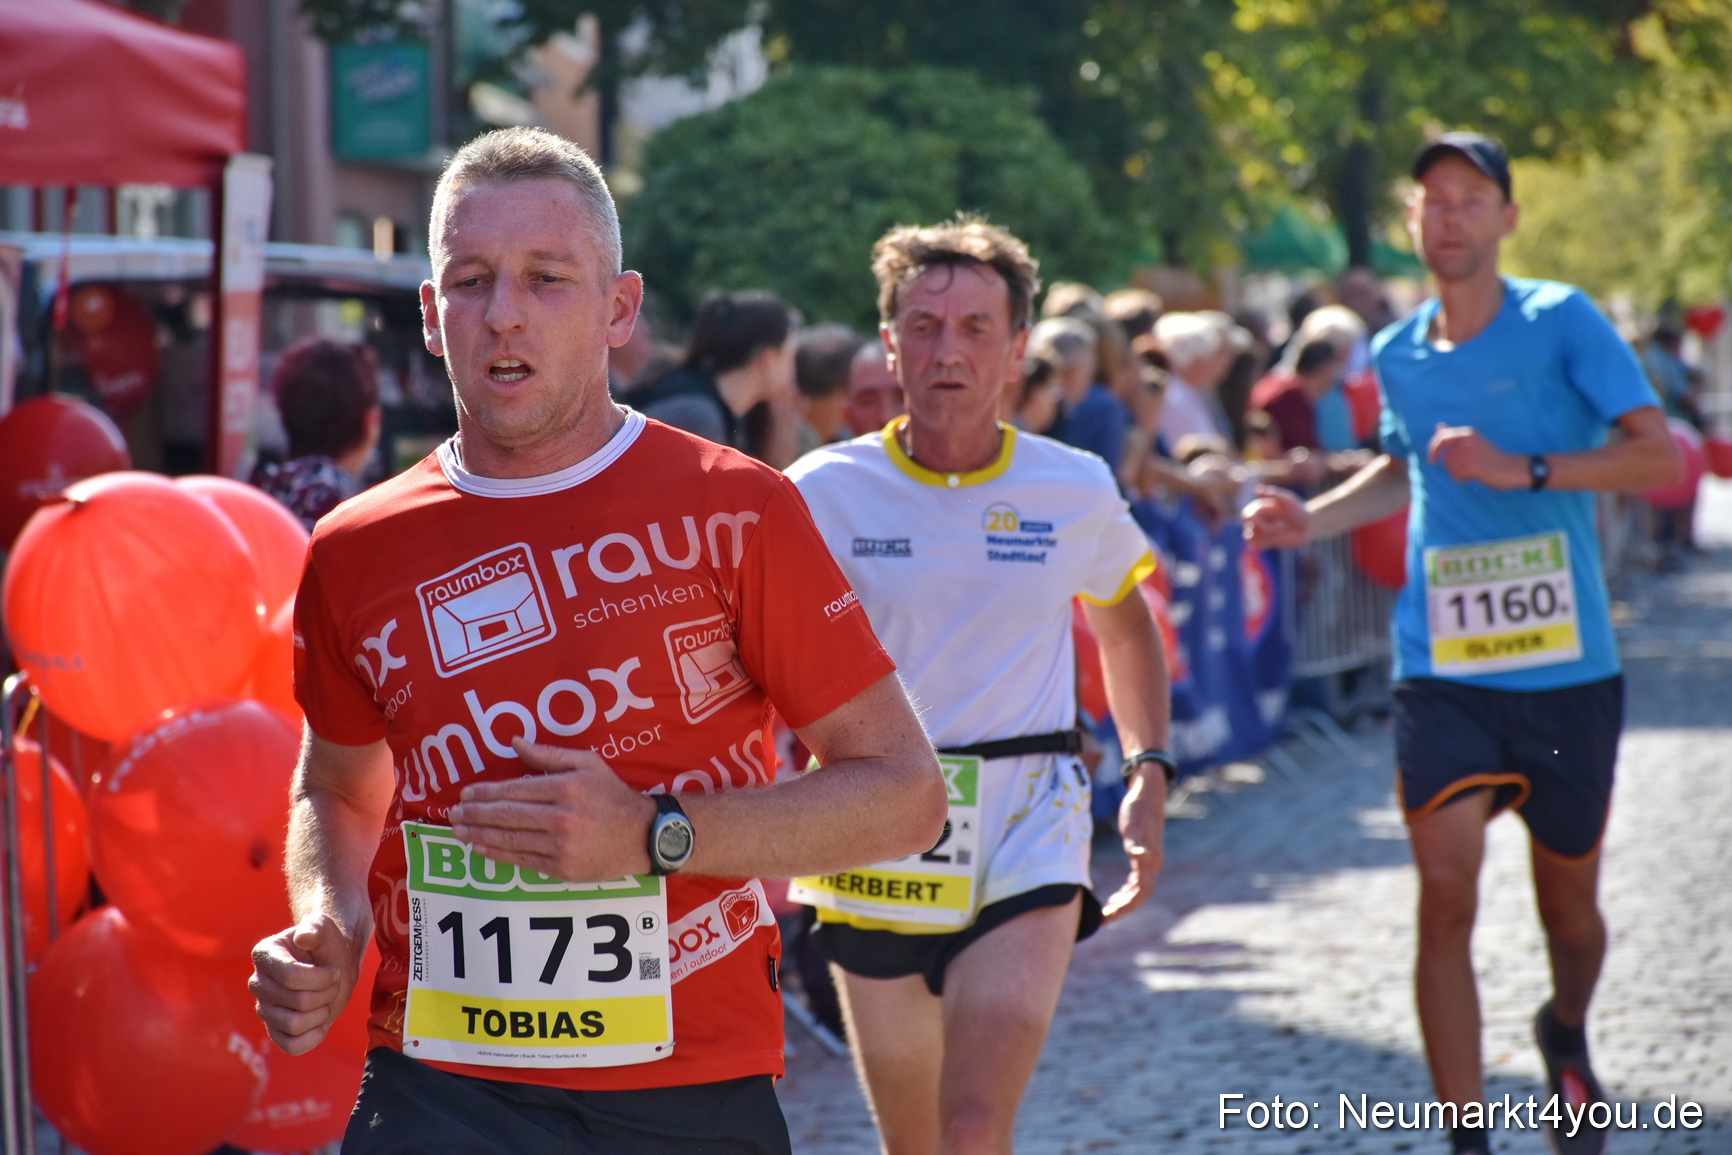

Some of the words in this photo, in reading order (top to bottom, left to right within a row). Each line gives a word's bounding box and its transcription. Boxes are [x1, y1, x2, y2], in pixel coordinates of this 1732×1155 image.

[987, 511, 1019, 531] 20
[426, 554, 525, 606] raumbox
[573, 583, 704, 628] schenken
[1448, 581, 1557, 631] 1160
[1465, 634, 1544, 660] OLIVER
[642, 917, 654, 930] B
[437, 911, 633, 985] 1173
[690, 943, 728, 968] outdoor
[461, 1006, 605, 1039] TOBIAS
